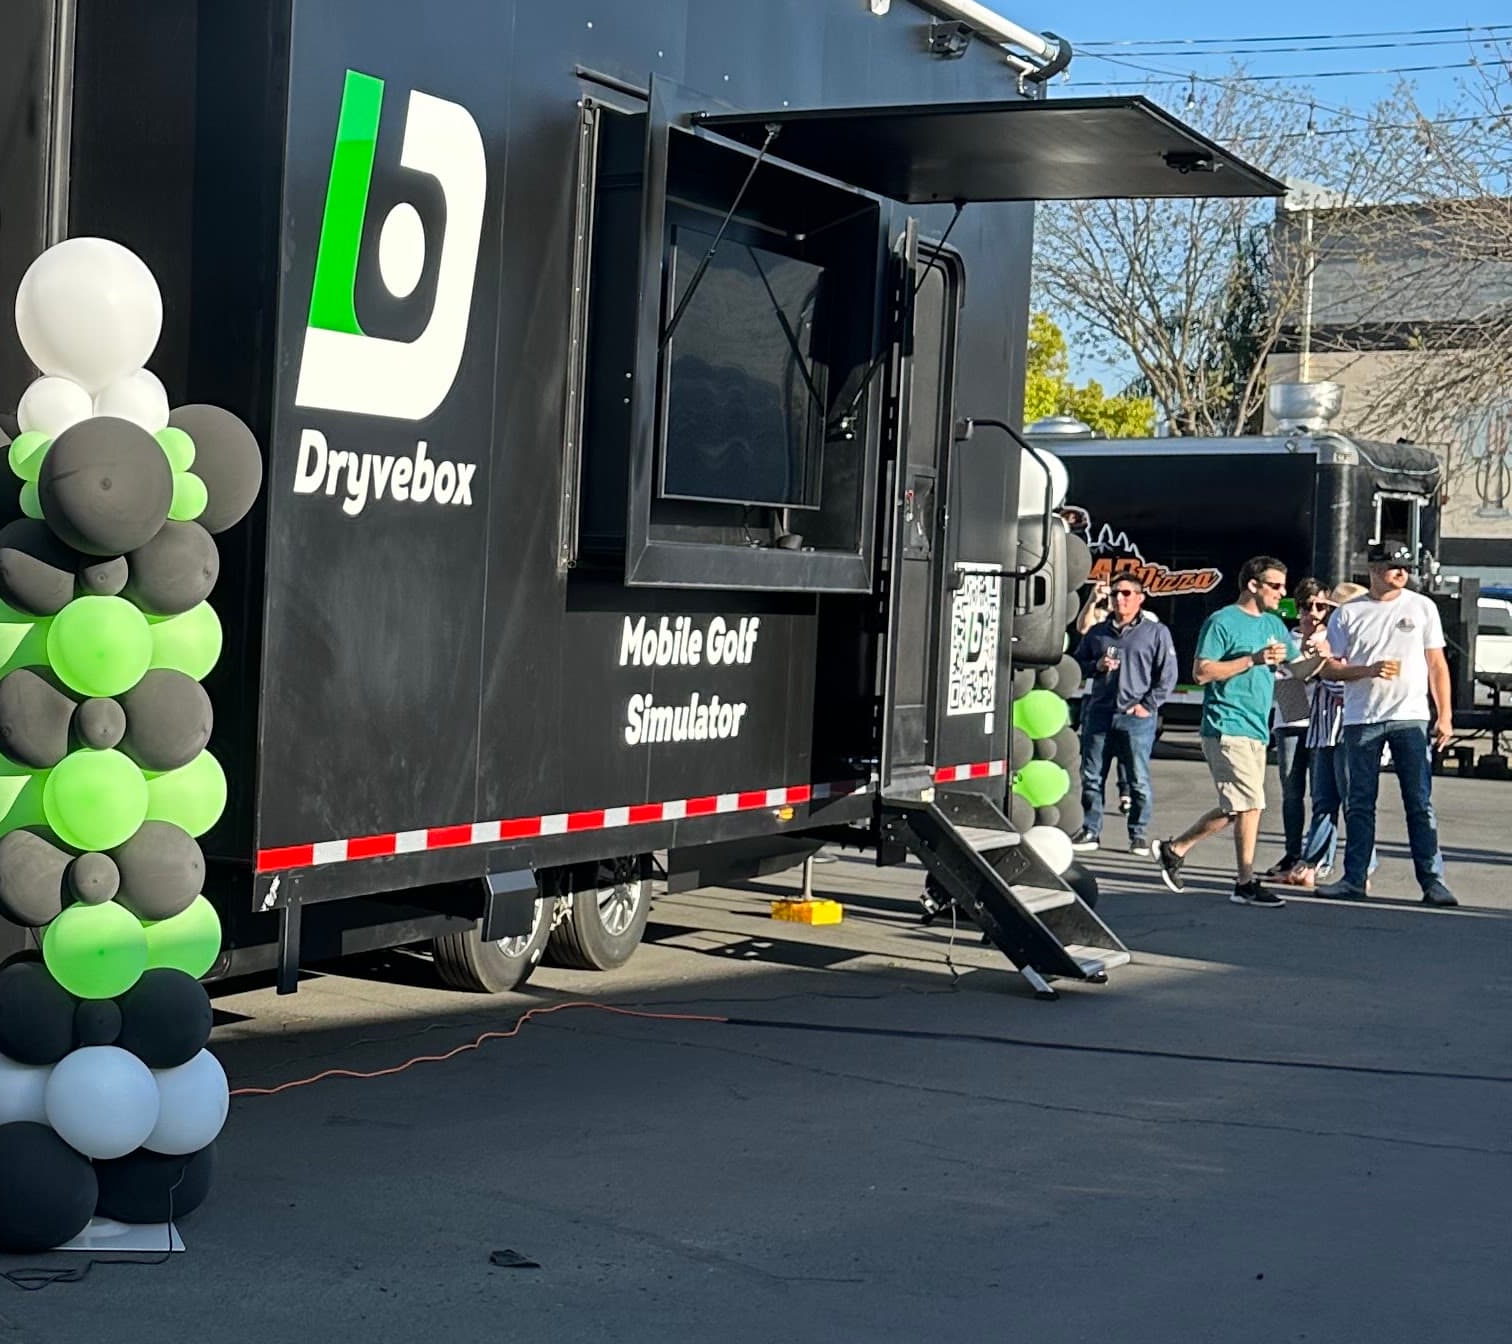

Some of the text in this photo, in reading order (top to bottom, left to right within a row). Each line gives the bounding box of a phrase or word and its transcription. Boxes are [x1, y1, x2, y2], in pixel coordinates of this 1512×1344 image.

[292, 428, 477, 516] Dryvebox
[619, 615, 761, 667] Mobile Golf
[624, 692, 749, 746] Simulator
